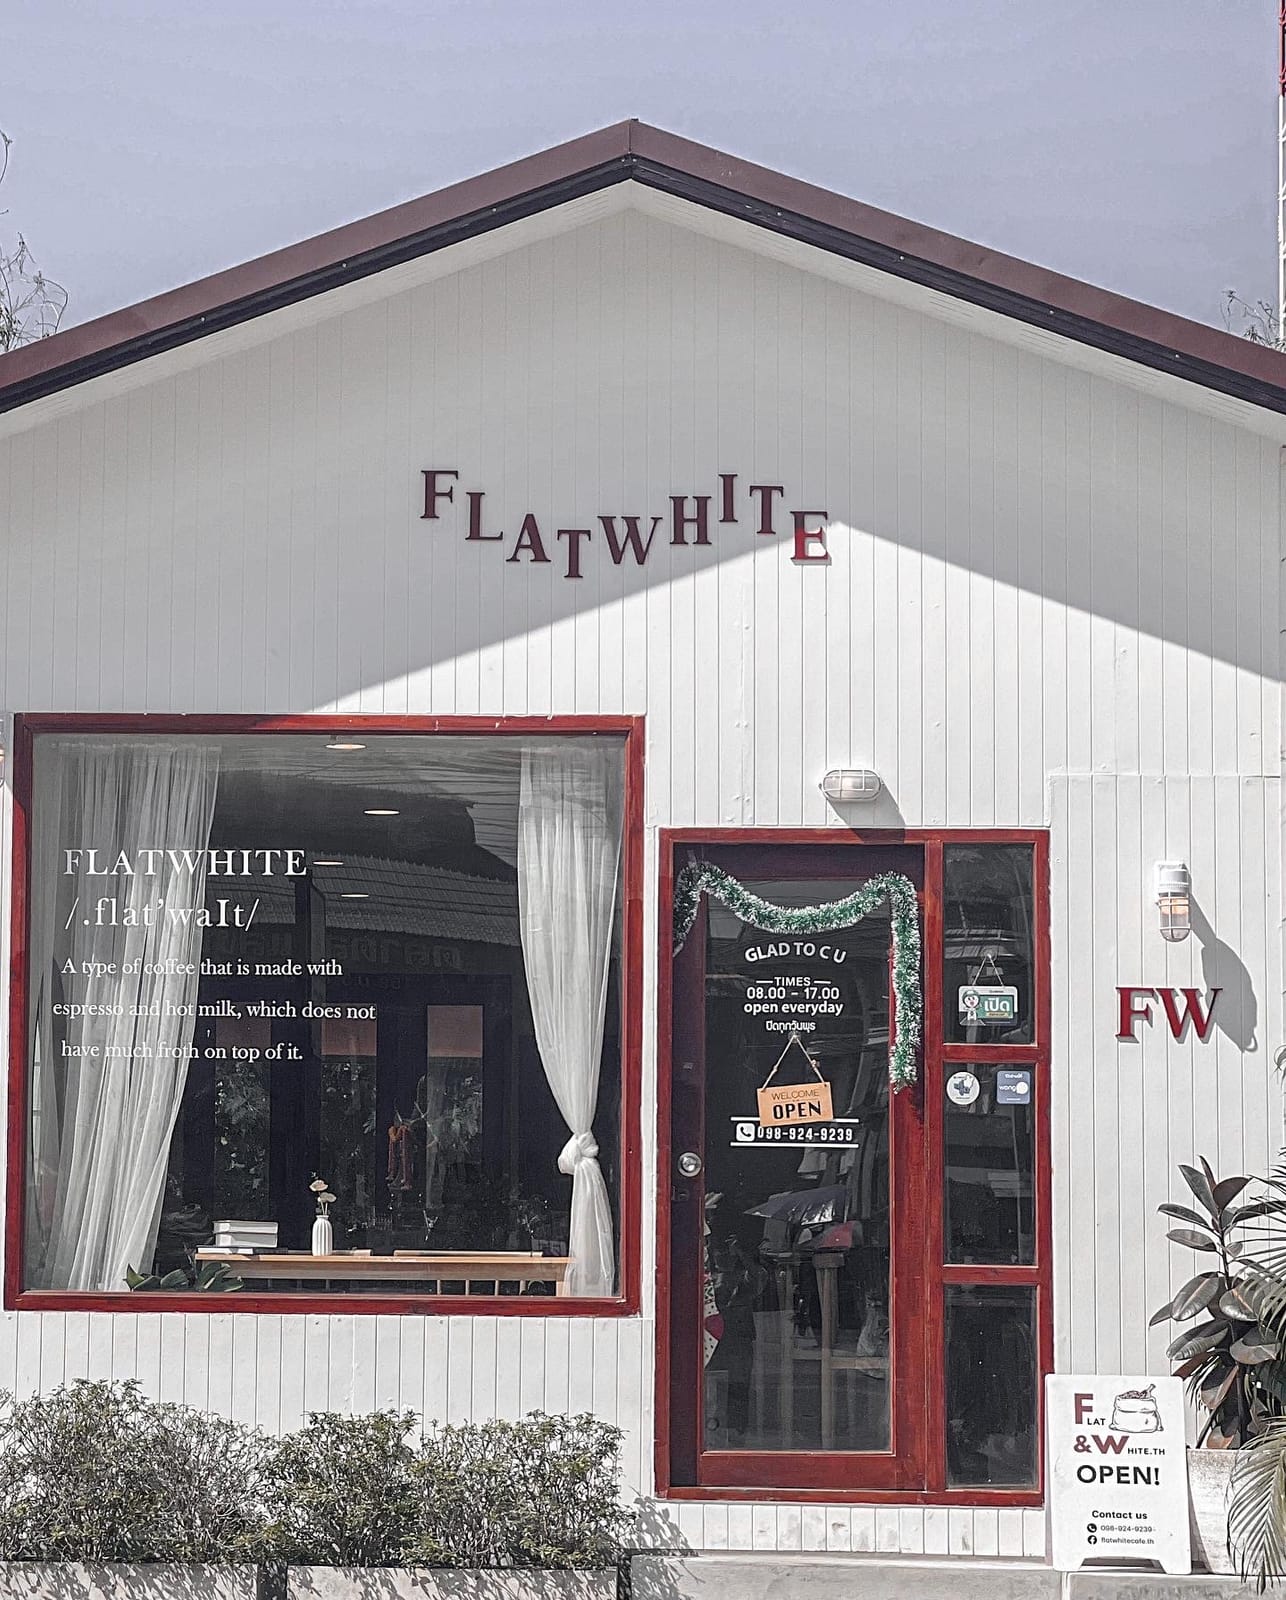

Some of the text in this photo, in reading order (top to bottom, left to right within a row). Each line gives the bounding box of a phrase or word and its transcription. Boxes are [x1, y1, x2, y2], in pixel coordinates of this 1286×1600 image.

[420, 470, 829, 579] FLATWHITE
[63, 848, 308, 877] FLATWHITE
[744, 942, 790, 962] GLAD
[793, 942, 816, 957] TO
[61, 958, 343, 979] A type of coffee that is made with
[774, 976, 811, 987] TIMES
[746, 986, 786, 1000] 08.00
[803, 986, 840, 1000] 17.00
[52, 1000, 376, 1020] espresso and hot milk, which does not
[743, 1000, 844, 1017] open everyday
[984, 997, 1010, 1012] เปิด
[1115, 987, 1223, 1041] FW
[60, 1040, 304, 1064] have much froth on top of it.
[771, 1088, 820, 1101] WELCOME
[772, 1101, 822, 1120] OPEN
[757, 1126, 853, 1142] 098-924-9239
[1076, 1464, 1161, 1486] OPEN!
[1091, 1510, 1148, 1519] Contact us
[1101, 1536, 1155, 1545] flatwhitecafe.th
